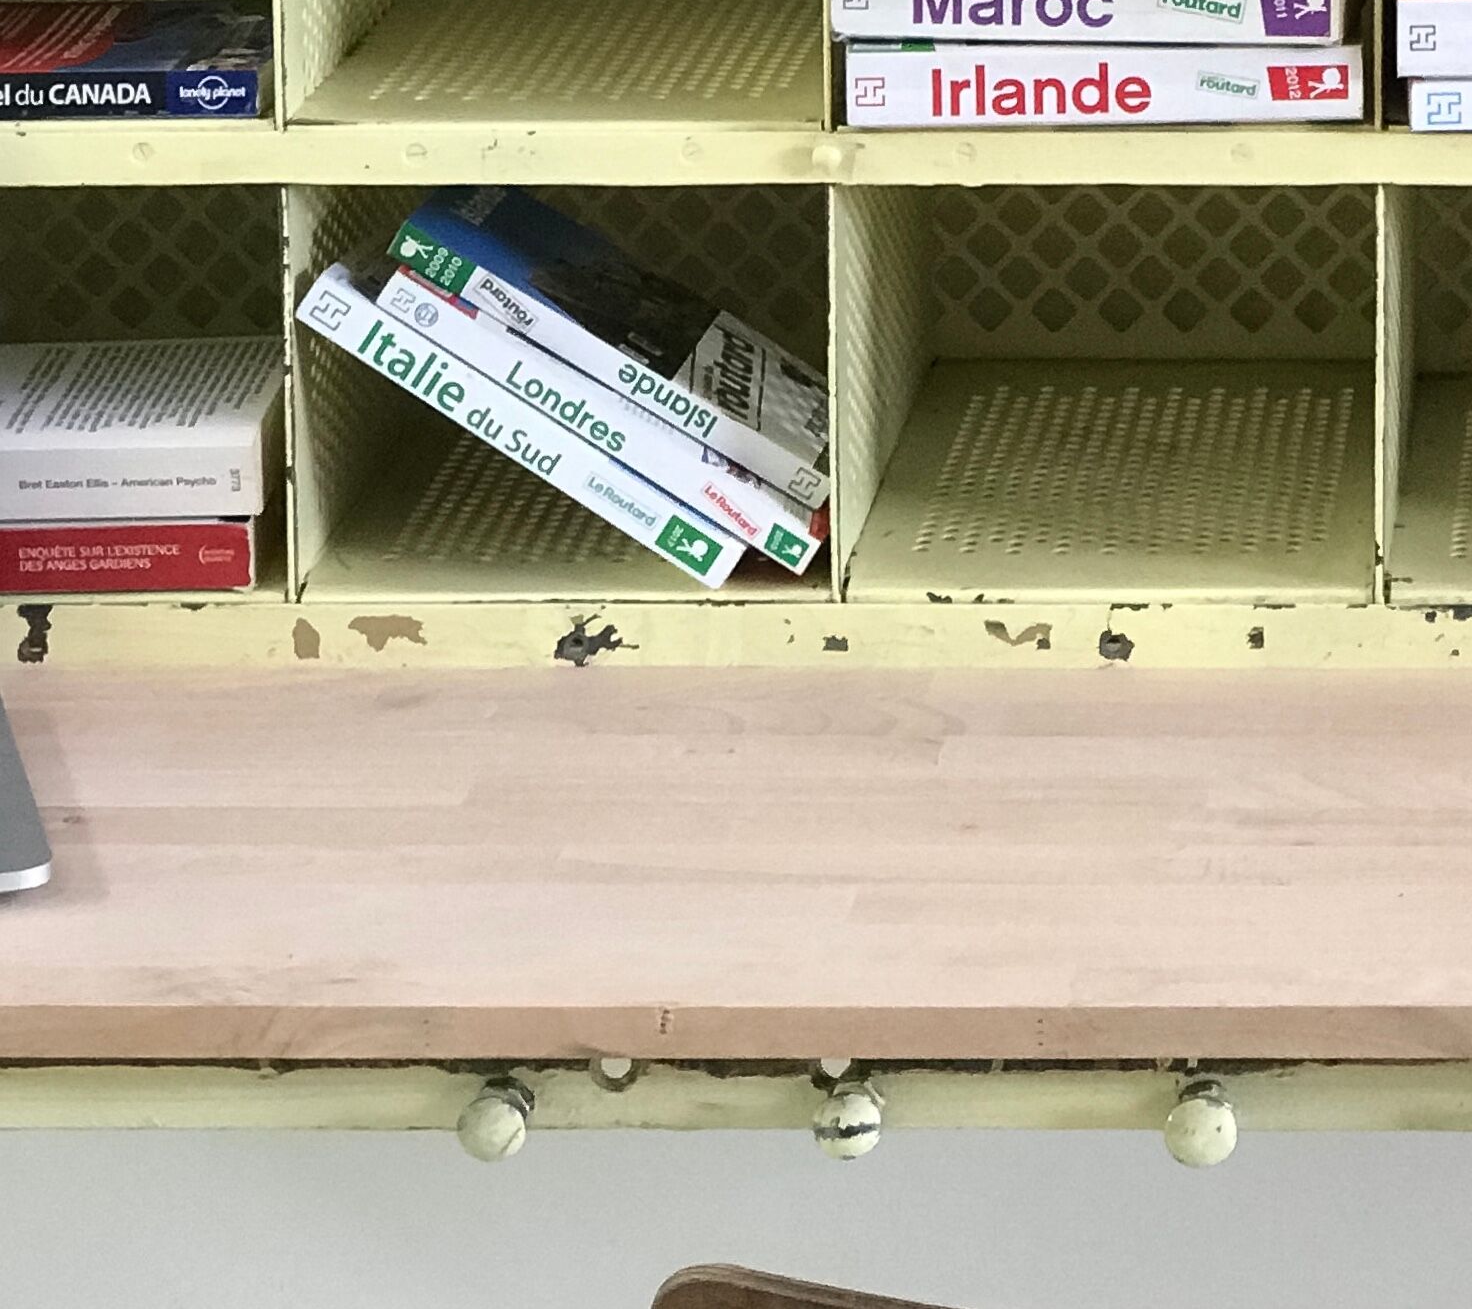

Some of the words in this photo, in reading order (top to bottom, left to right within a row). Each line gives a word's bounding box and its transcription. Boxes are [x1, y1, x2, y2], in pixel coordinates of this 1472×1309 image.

[15, 84, 43, 106] du
[49, 83, 151, 106] CANADA
[179, 86, 211, 101] lonely
[212, 86, 245, 100] planet
[931, 62, 1152, 117] Irlande
[1199, 77, 1257, 97] routard
[1284, 66, 1301, 99] 2012
[424, 247, 449, 279] 2009
[440, 256, 463, 286] 2010
[481, 278, 536, 327] routard
[618, 363, 719, 439] Islande
[356, 319, 466, 413] Italie
[466, 407, 504, 440] du
[504, 430, 563, 476] Sud
[587, 475, 604, 493] Le
[602, 486, 658, 528] Routard
[505, 360, 627, 453] Londres
[704, 484, 717, 499] Le
[714, 495, 758, 537] Routard
[18, 480, 43, 490] Bret
[45, 479, 84, 489] Easton
[86, 478, 109, 488] Ellis
[120, 477, 173, 488] American
[175, 476, 217, 488] Psycho
[18, 544, 77, 561] ENQUÊTE
[79, 545, 104, 558] SUR
[107, 544, 180, 557] L'EXISTENCE
[19, 558, 43, 571] DES
[46, 558, 87, 571] ANGES
[89, 556, 152, 570] GARDIENS
